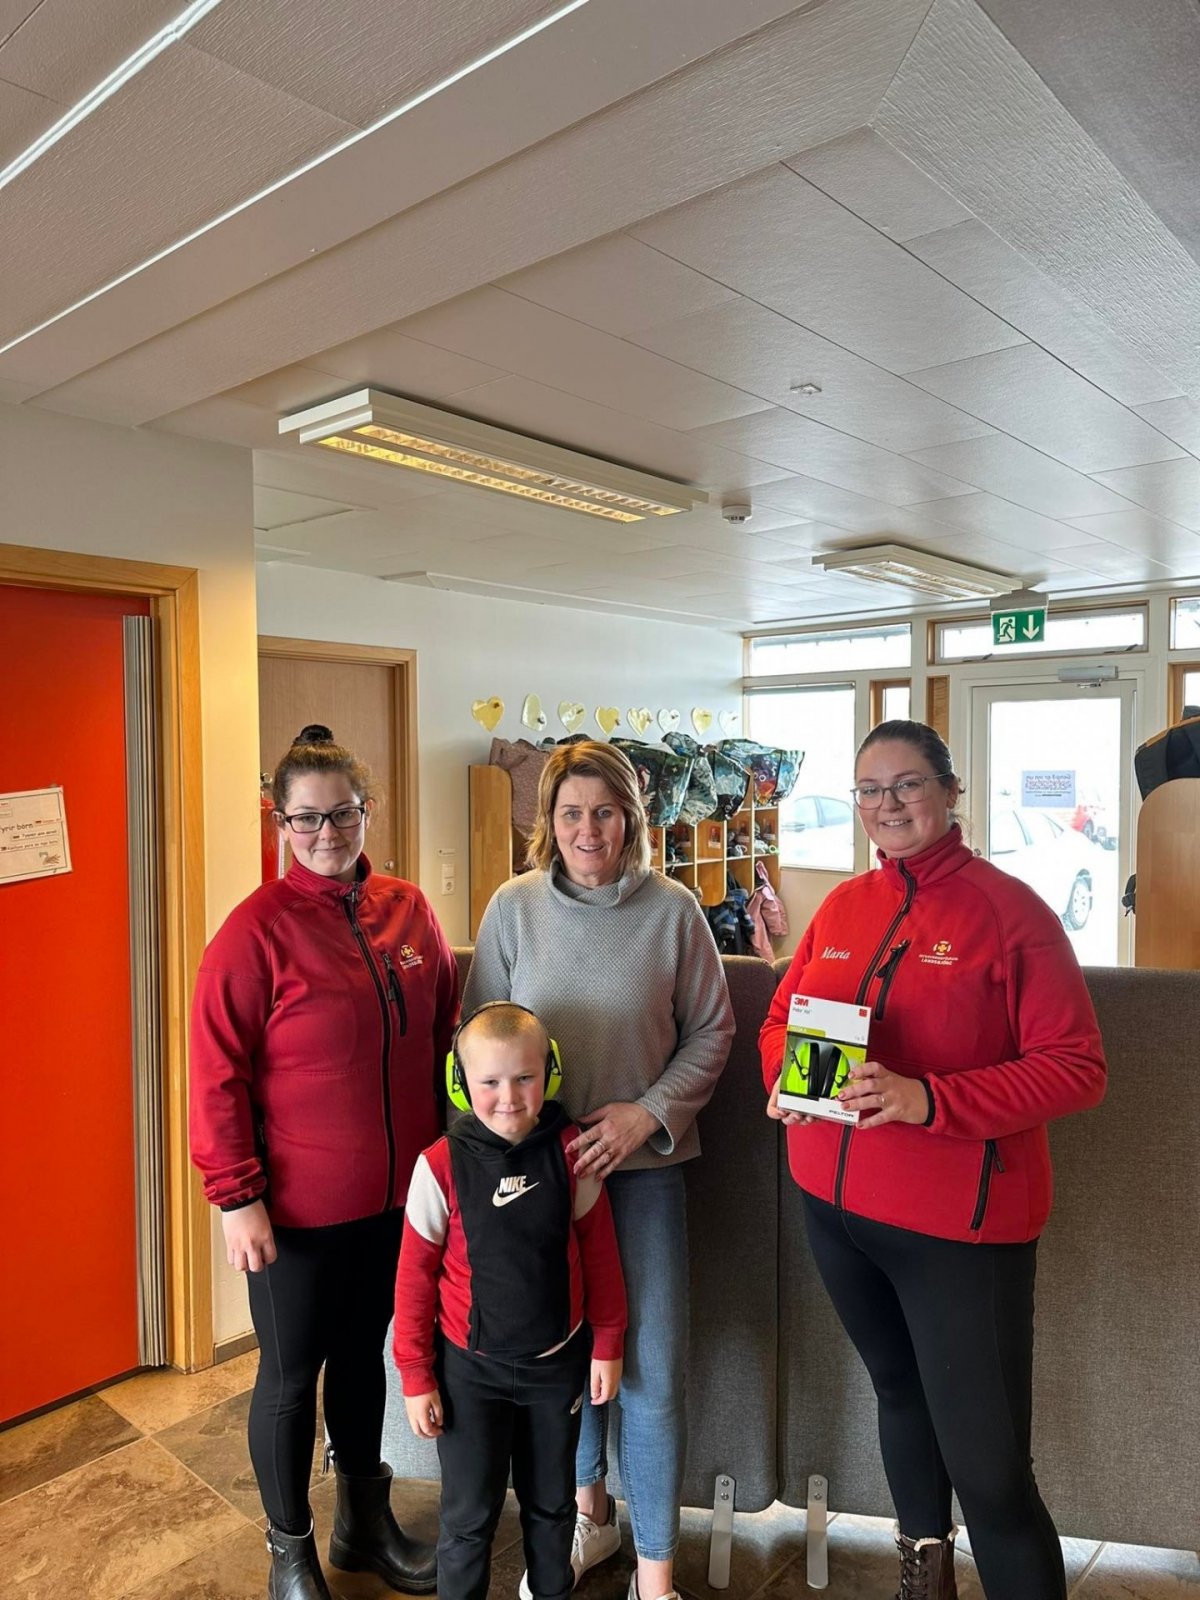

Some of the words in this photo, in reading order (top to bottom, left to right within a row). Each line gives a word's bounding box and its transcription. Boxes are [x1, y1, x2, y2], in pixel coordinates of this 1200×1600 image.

[794, 997, 809, 1007] 3M
[828, 1109, 854, 1118] PELTOR
[499, 1175, 527, 1193] NIKE
